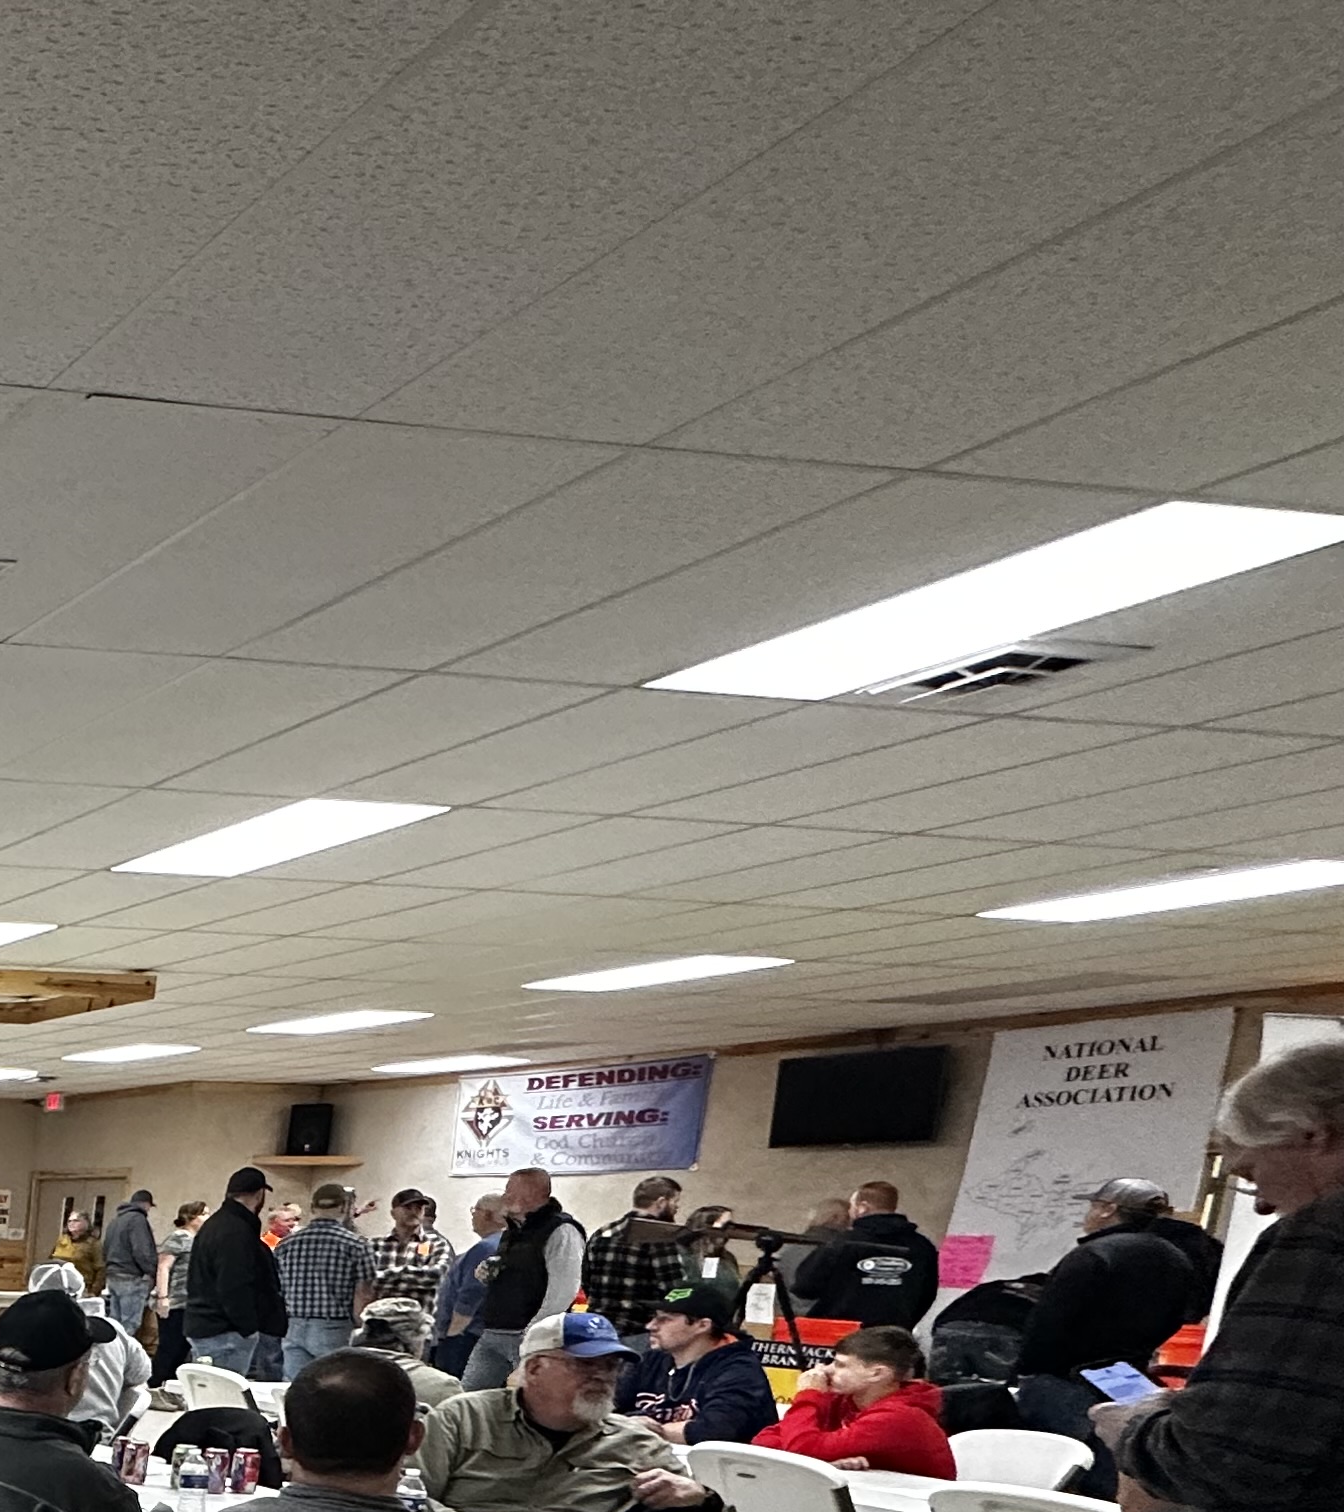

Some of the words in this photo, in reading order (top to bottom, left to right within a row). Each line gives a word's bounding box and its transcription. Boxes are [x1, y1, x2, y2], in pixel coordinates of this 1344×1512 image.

[1042, 1035, 1164, 1062] NATIONAL
[526, 1061, 704, 1091] DEFENDING:
[1064, 1062, 1131, 1083] DEER
[536, 1093, 575, 1111] Life
[579, 1092, 596, 1107] &
[1016, 1082, 1177, 1109] ASSOCIATION
[533, 1108, 669, 1130] SERVING:
[456, 1148, 509, 1159] KNIGHTS
[530, 1151, 547, 1166] &
